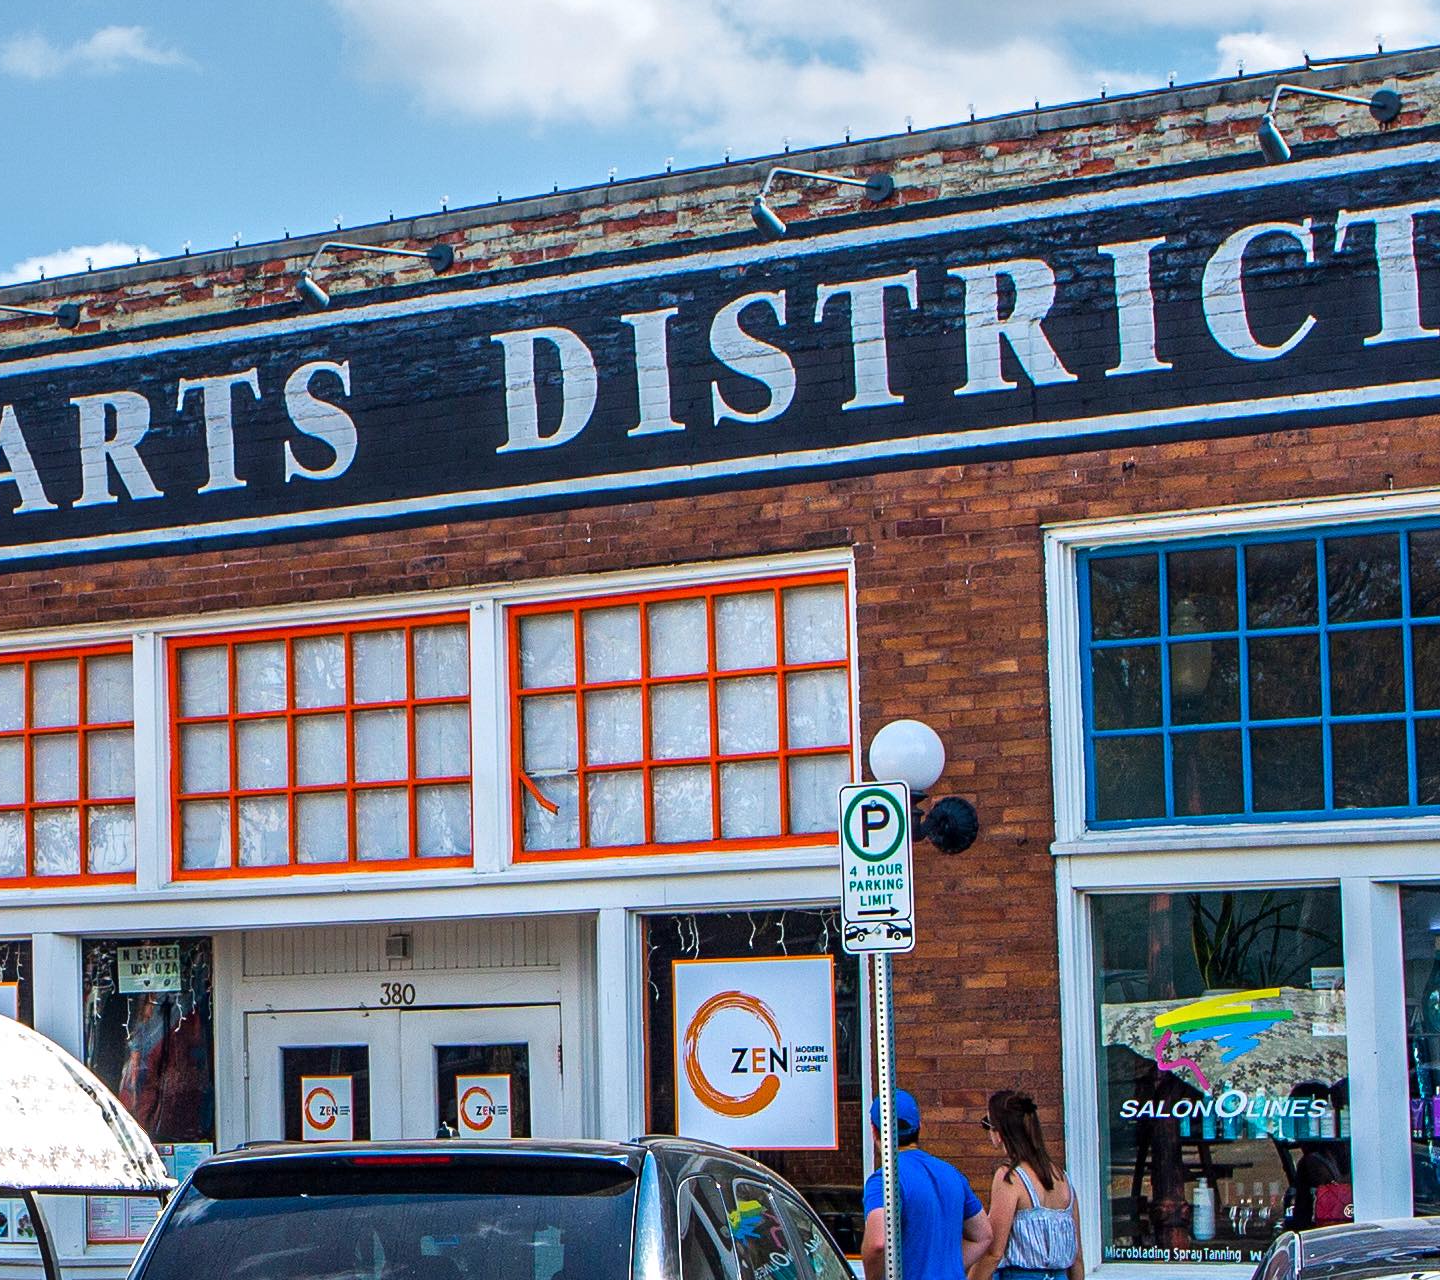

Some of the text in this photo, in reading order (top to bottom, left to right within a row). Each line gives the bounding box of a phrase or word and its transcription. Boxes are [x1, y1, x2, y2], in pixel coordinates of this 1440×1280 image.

[861, 804, 890, 848] P
[849, 863, 903, 877] 4 HOUR
[849, 878, 904, 892] PARKING
[860, 893, 893, 907] LIMIT
[380, 982, 416, 1005] 380
[795, 1045, 825, 1054] MODERN
[731, 1046, 788, 1074] ZEN
[795, 1055, 829, 1064] JAPANESE
[795, 1065, 822, 1073] CUISINE
[319, 1105, 338, 1116] ZEN
[476, 1105, 496, 1116] ZEN
[1104, 1244, 1170, 1262] Microblading
[1173, 1247, 1202, 1262] Spray
[1204, 1246, 1242, 1262] Tanning
